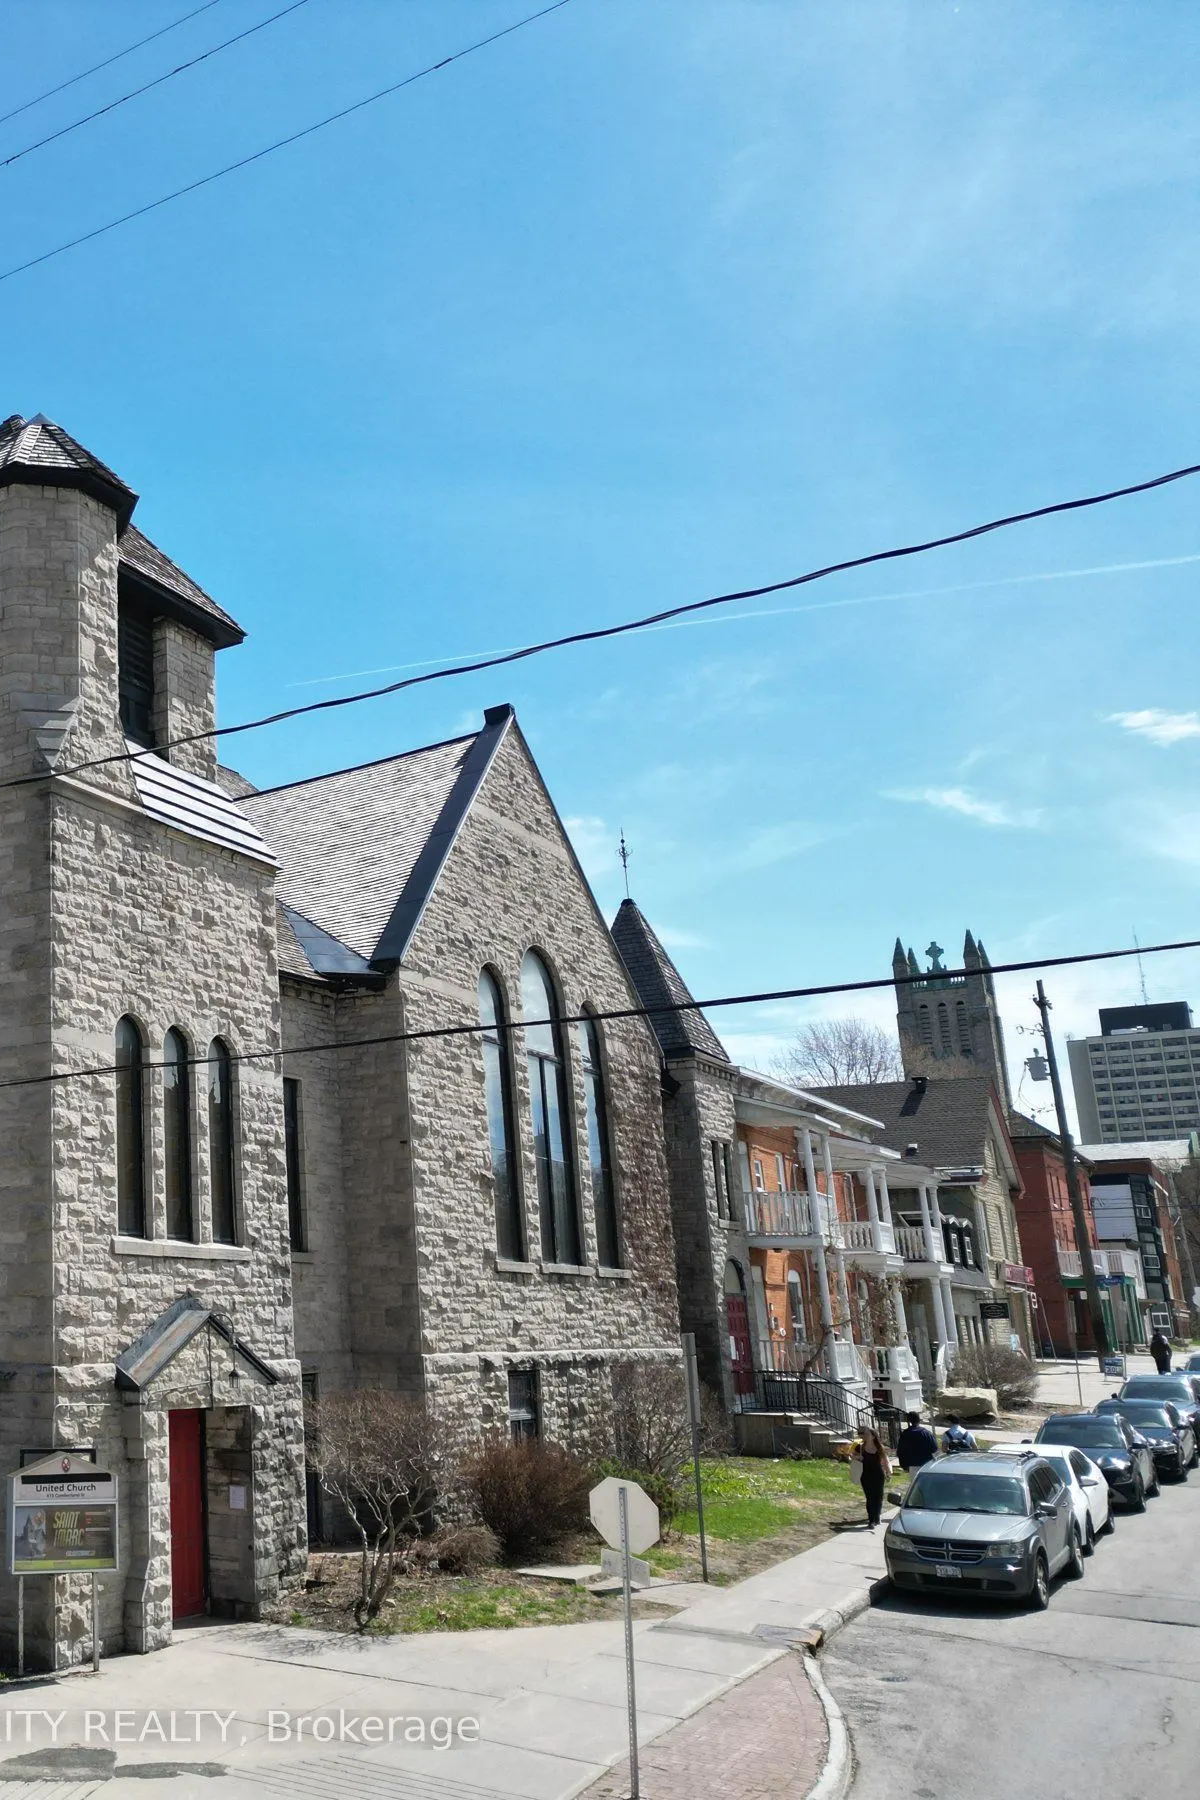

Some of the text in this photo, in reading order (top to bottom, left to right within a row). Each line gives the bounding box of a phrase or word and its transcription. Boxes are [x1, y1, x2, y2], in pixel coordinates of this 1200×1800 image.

[36, 1483, 96, 1492] United Church
[53, 1511, 81, 1529] SAINT
